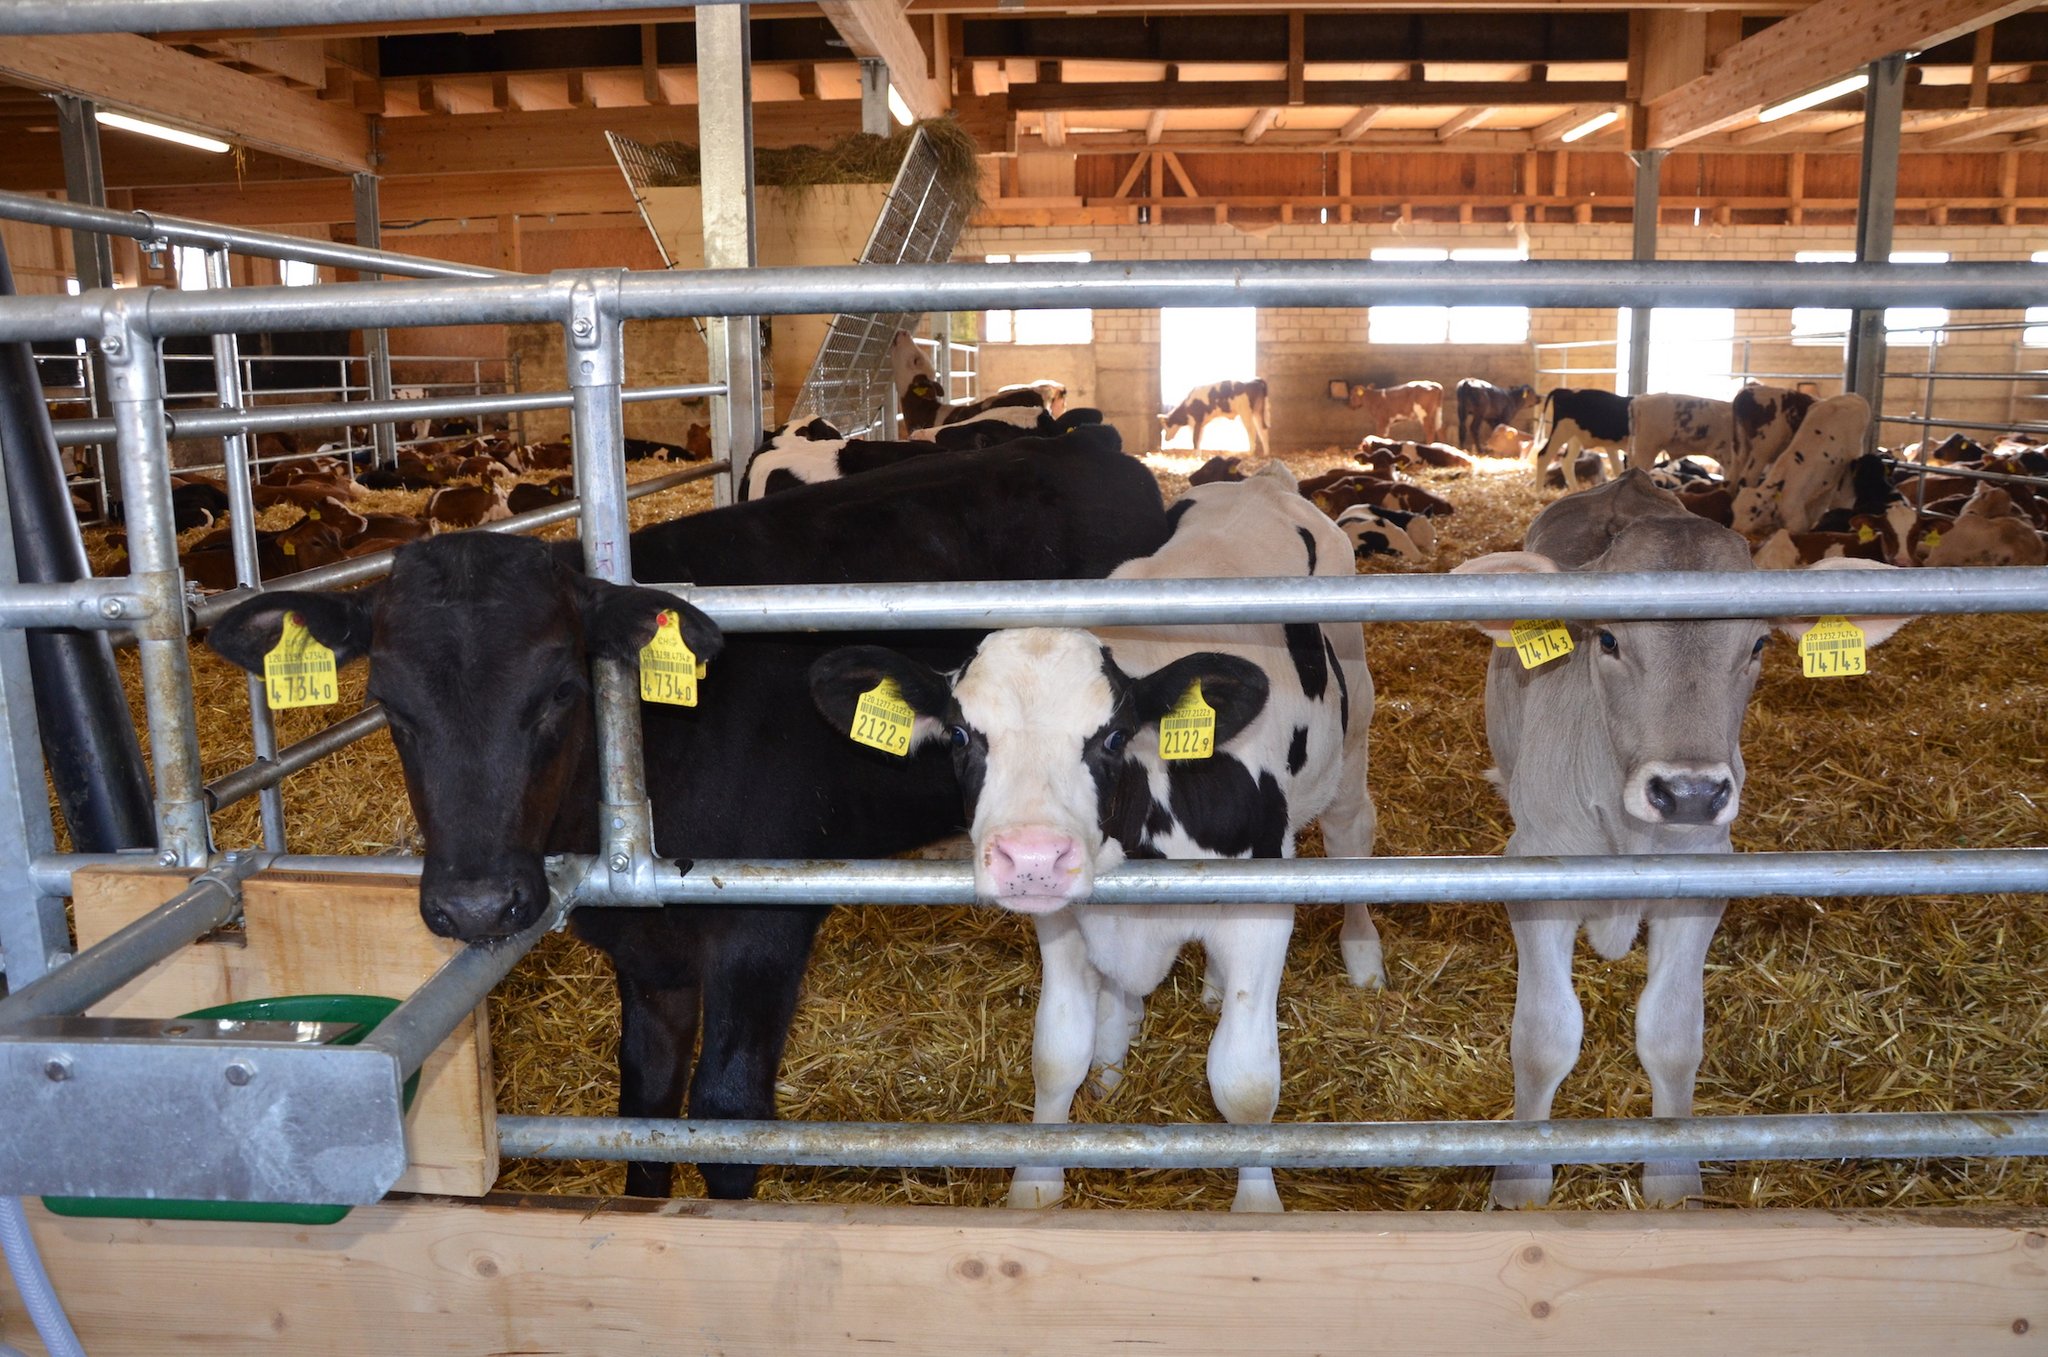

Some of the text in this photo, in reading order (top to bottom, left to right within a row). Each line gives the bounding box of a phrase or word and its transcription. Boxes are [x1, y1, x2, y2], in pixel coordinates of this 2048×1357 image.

[1519, 634, 1569, 664] 74743
[1807, 650, 1861, 673] 74743
[271, 675, 332, 703] 47340
[643, 671, 692, 701] 47340
[857, 714, 906, 750] 21229
[1164, 729, 1209, 754] 21229
